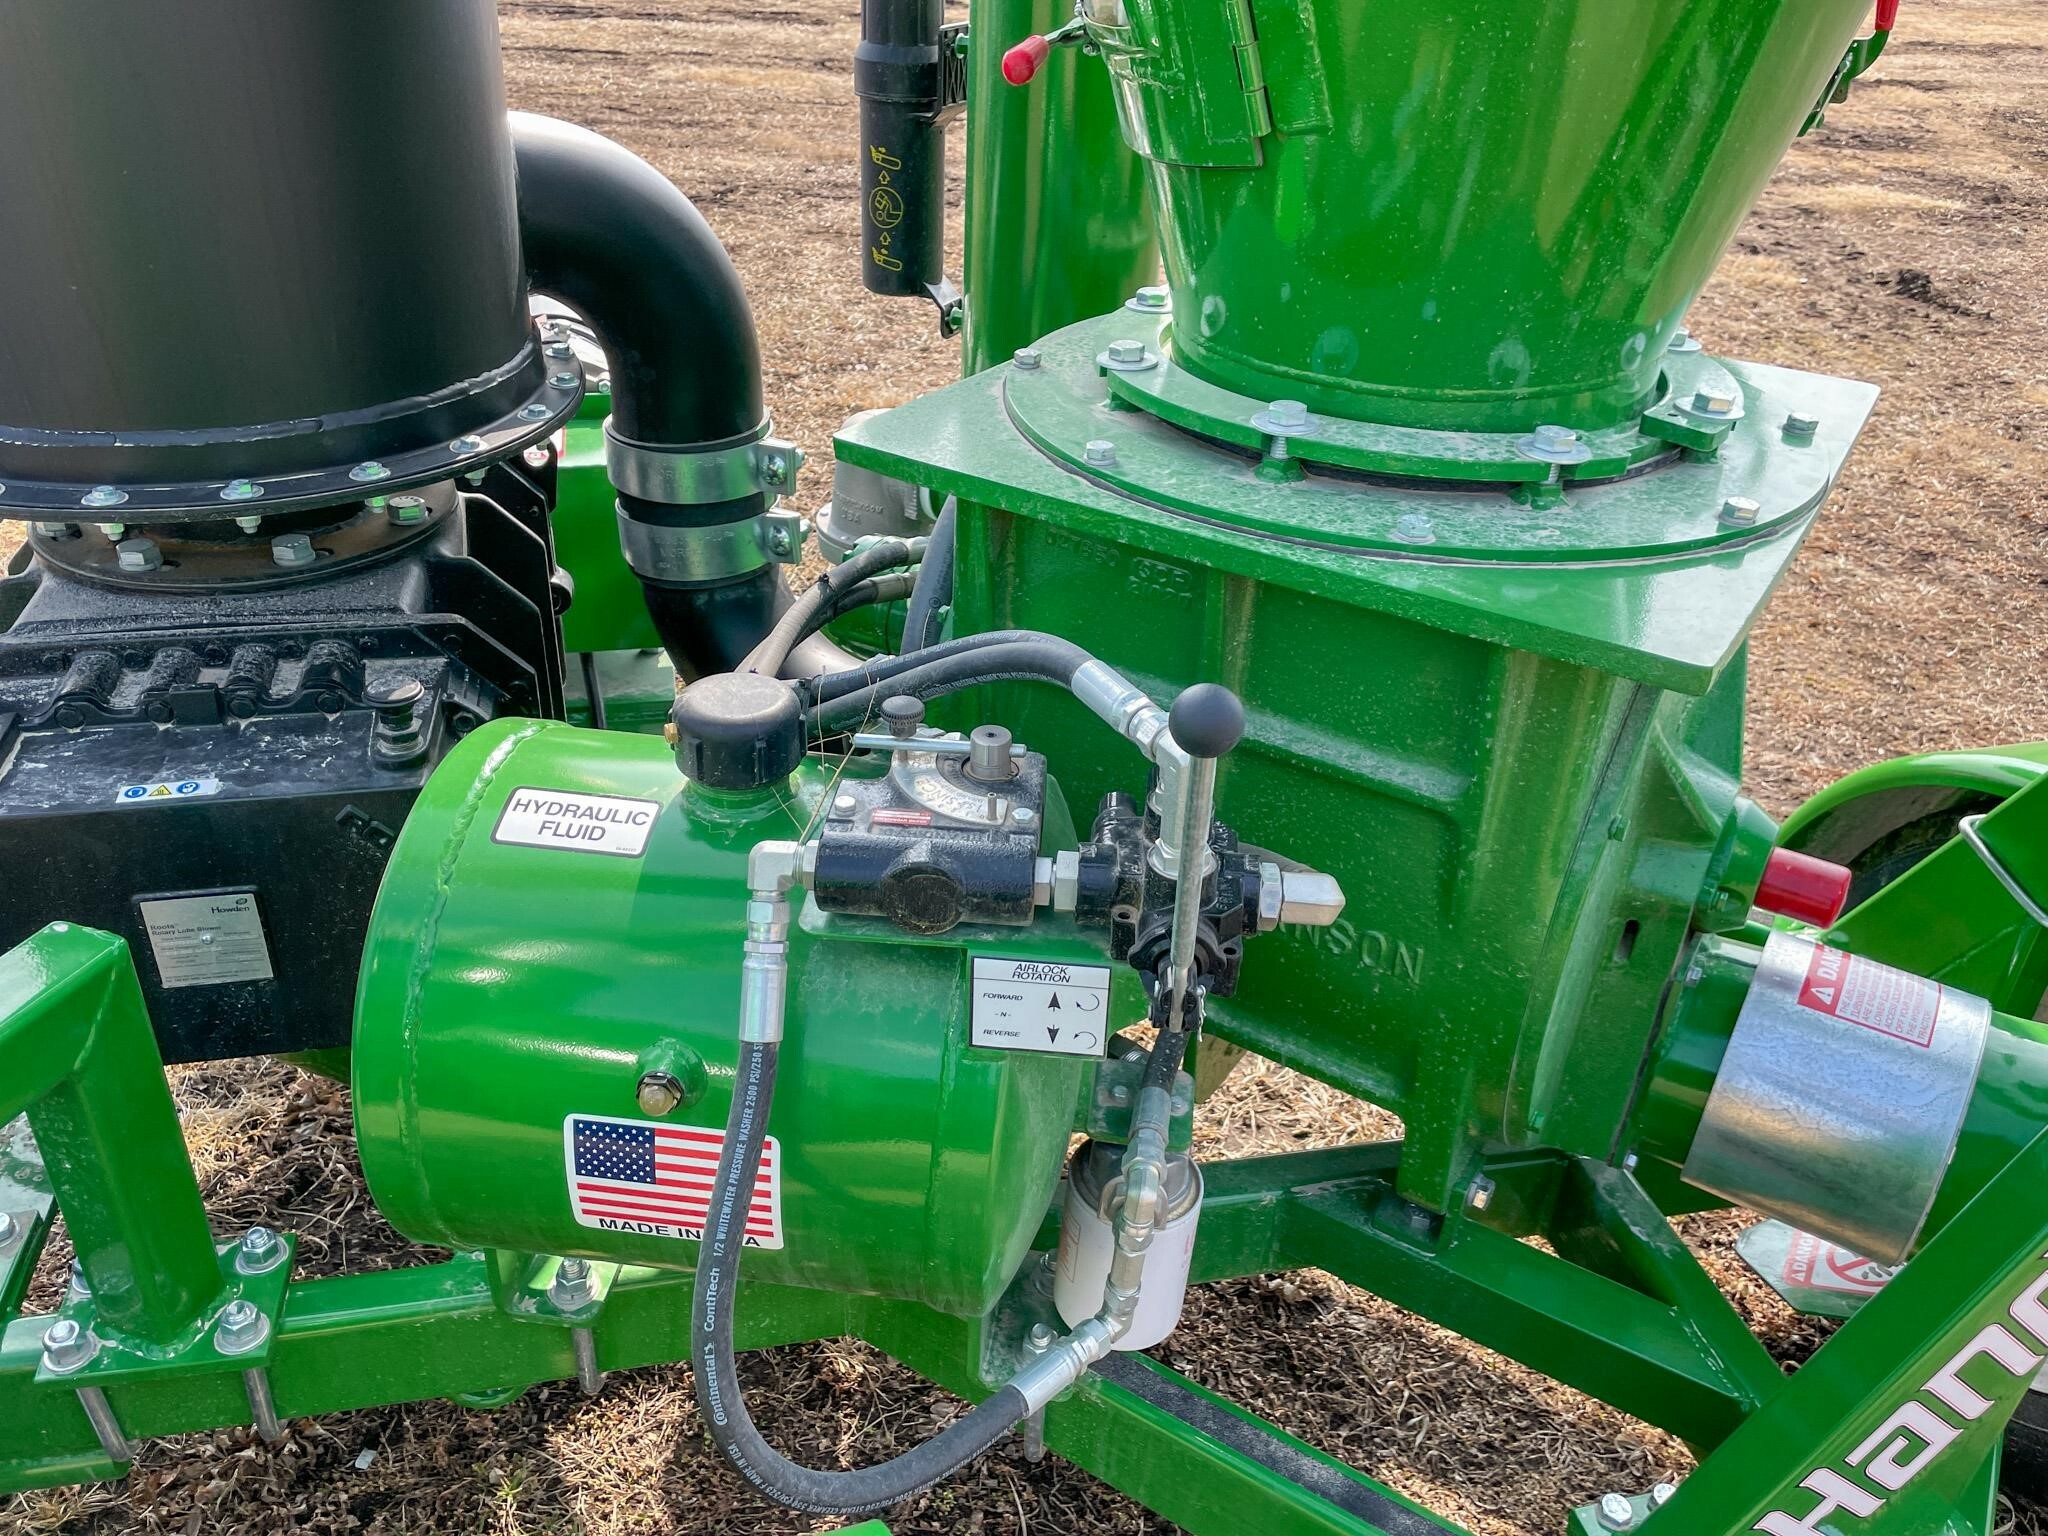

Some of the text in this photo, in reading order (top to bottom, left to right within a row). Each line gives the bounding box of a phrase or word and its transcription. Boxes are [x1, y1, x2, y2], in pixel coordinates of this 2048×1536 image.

[512, 798, 650, 826] HYDRAULIC
[538, 820, 606, 841] FLUID
[211, 906, 250, 914] Howden
[1012, 971, 1071, 983] ROTATION
[1014, 963, 1070, 975] AIRLOCK
[983, 992, 1023, 1001] FORWARD
[983, 1029, 1021, 1037] REVERSE
[749, 1052, 763, 1083] PSI/250
[746, 1085, 758, 1107] 2500
[739, 1108, 754, 1141] WASHER
[729, 1143, 747, 1184] PRESSURE
[716, 1185, 737, 1240] WHITEWATER
[599, 1218, 701, 1240] MADE IN
[713, 1243, 725, 1257] 1/2
[1792, 1235, 1815, 1270] DANG
[704, 1267, 720, 1332] ContiTech
[703, 1352, 728, 1426] Continental
